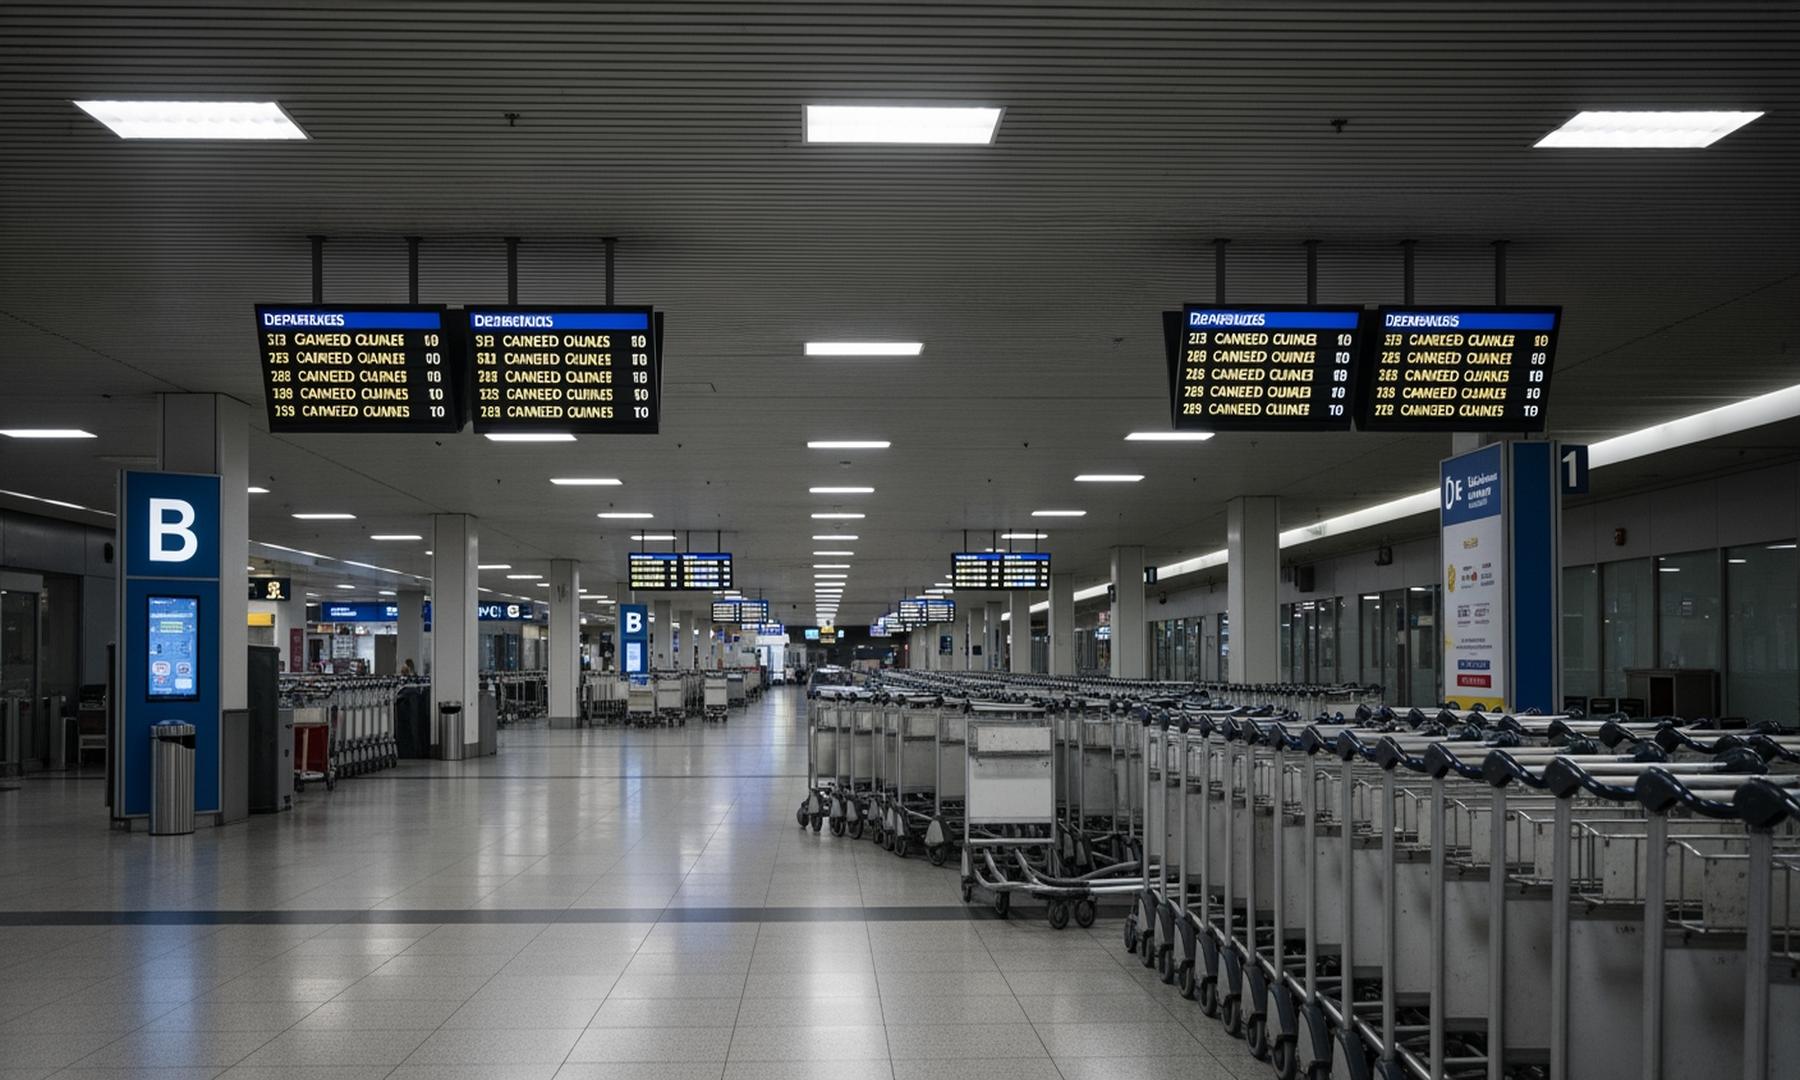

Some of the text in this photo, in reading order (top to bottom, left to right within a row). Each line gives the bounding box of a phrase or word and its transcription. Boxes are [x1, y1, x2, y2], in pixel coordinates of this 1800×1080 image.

[1562, 450, 1577, 487] 1
[149, 498, 198, 562] B
[626, 612, 642, 633] B
